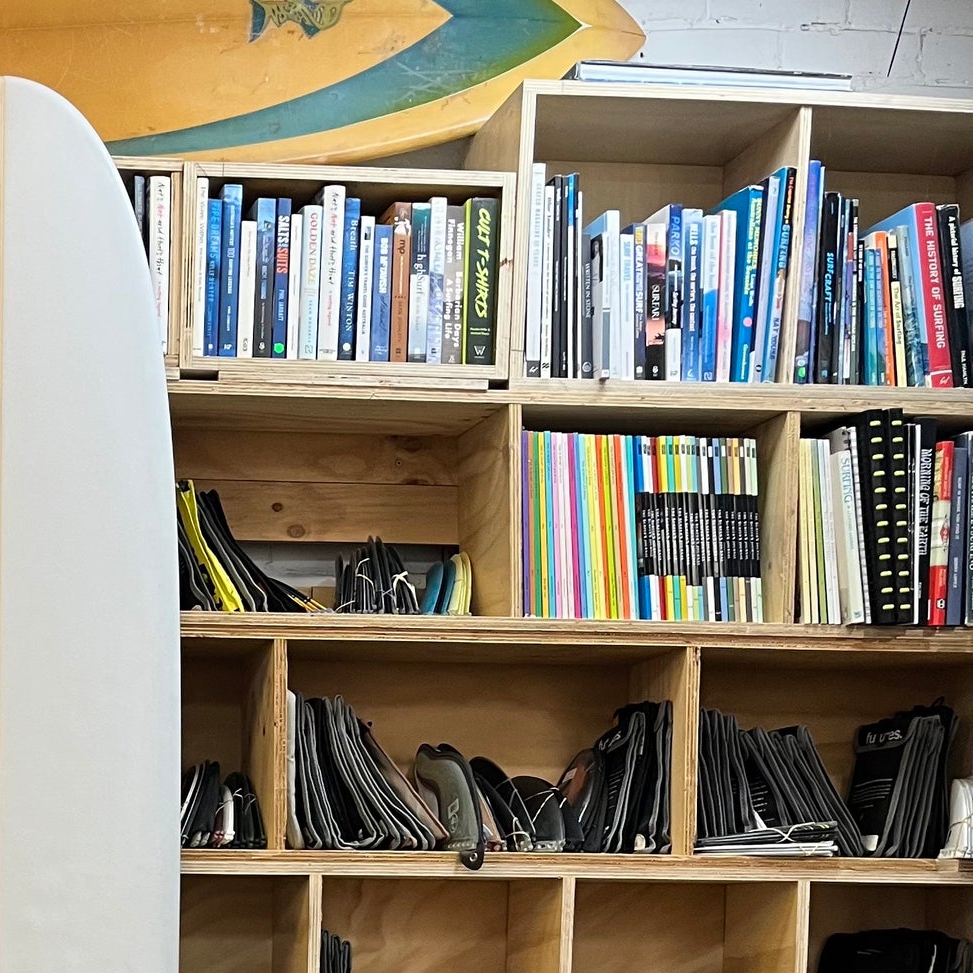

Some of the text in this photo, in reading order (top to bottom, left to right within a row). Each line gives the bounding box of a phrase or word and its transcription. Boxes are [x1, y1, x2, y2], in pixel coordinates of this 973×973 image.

[209, 224, 220, 259] DREAMS
[277, 216, 290, 242] SALTS
[349, 220, 358, 250] Breath
[477, 208, 491, 247] CULT
[671, 216, 681, 256] PARKO
[779, 224, 791, 268] SURFING
[949, 223, 958, 246] pictorial
[276, 248, 289, 274] SUITS
[307, 212, 319, 285] GOLDEN DAZE
[951, 247, 959, 268] history
[444, 219, 455, 340] Finnegan A Surfing Life
[453, 222, 465, 348] William Barbarian Days
[475, 249, 490, 318] T-SHIRTS
[924, 216, 945, 348] THE HISTORY OF SURFING
[952, 276, 965, 308] SURFING
[345, 270, 355, 332] TIM WINTON
[635, 292, 643, 314] SURF
[652, 285, 660, 320] SURFARI
[895, 320, 903, 345] Surfing
[840, 458, 853, 504] SURFING
[919, 449, 933, 556] MORNING OF THE EARTH
